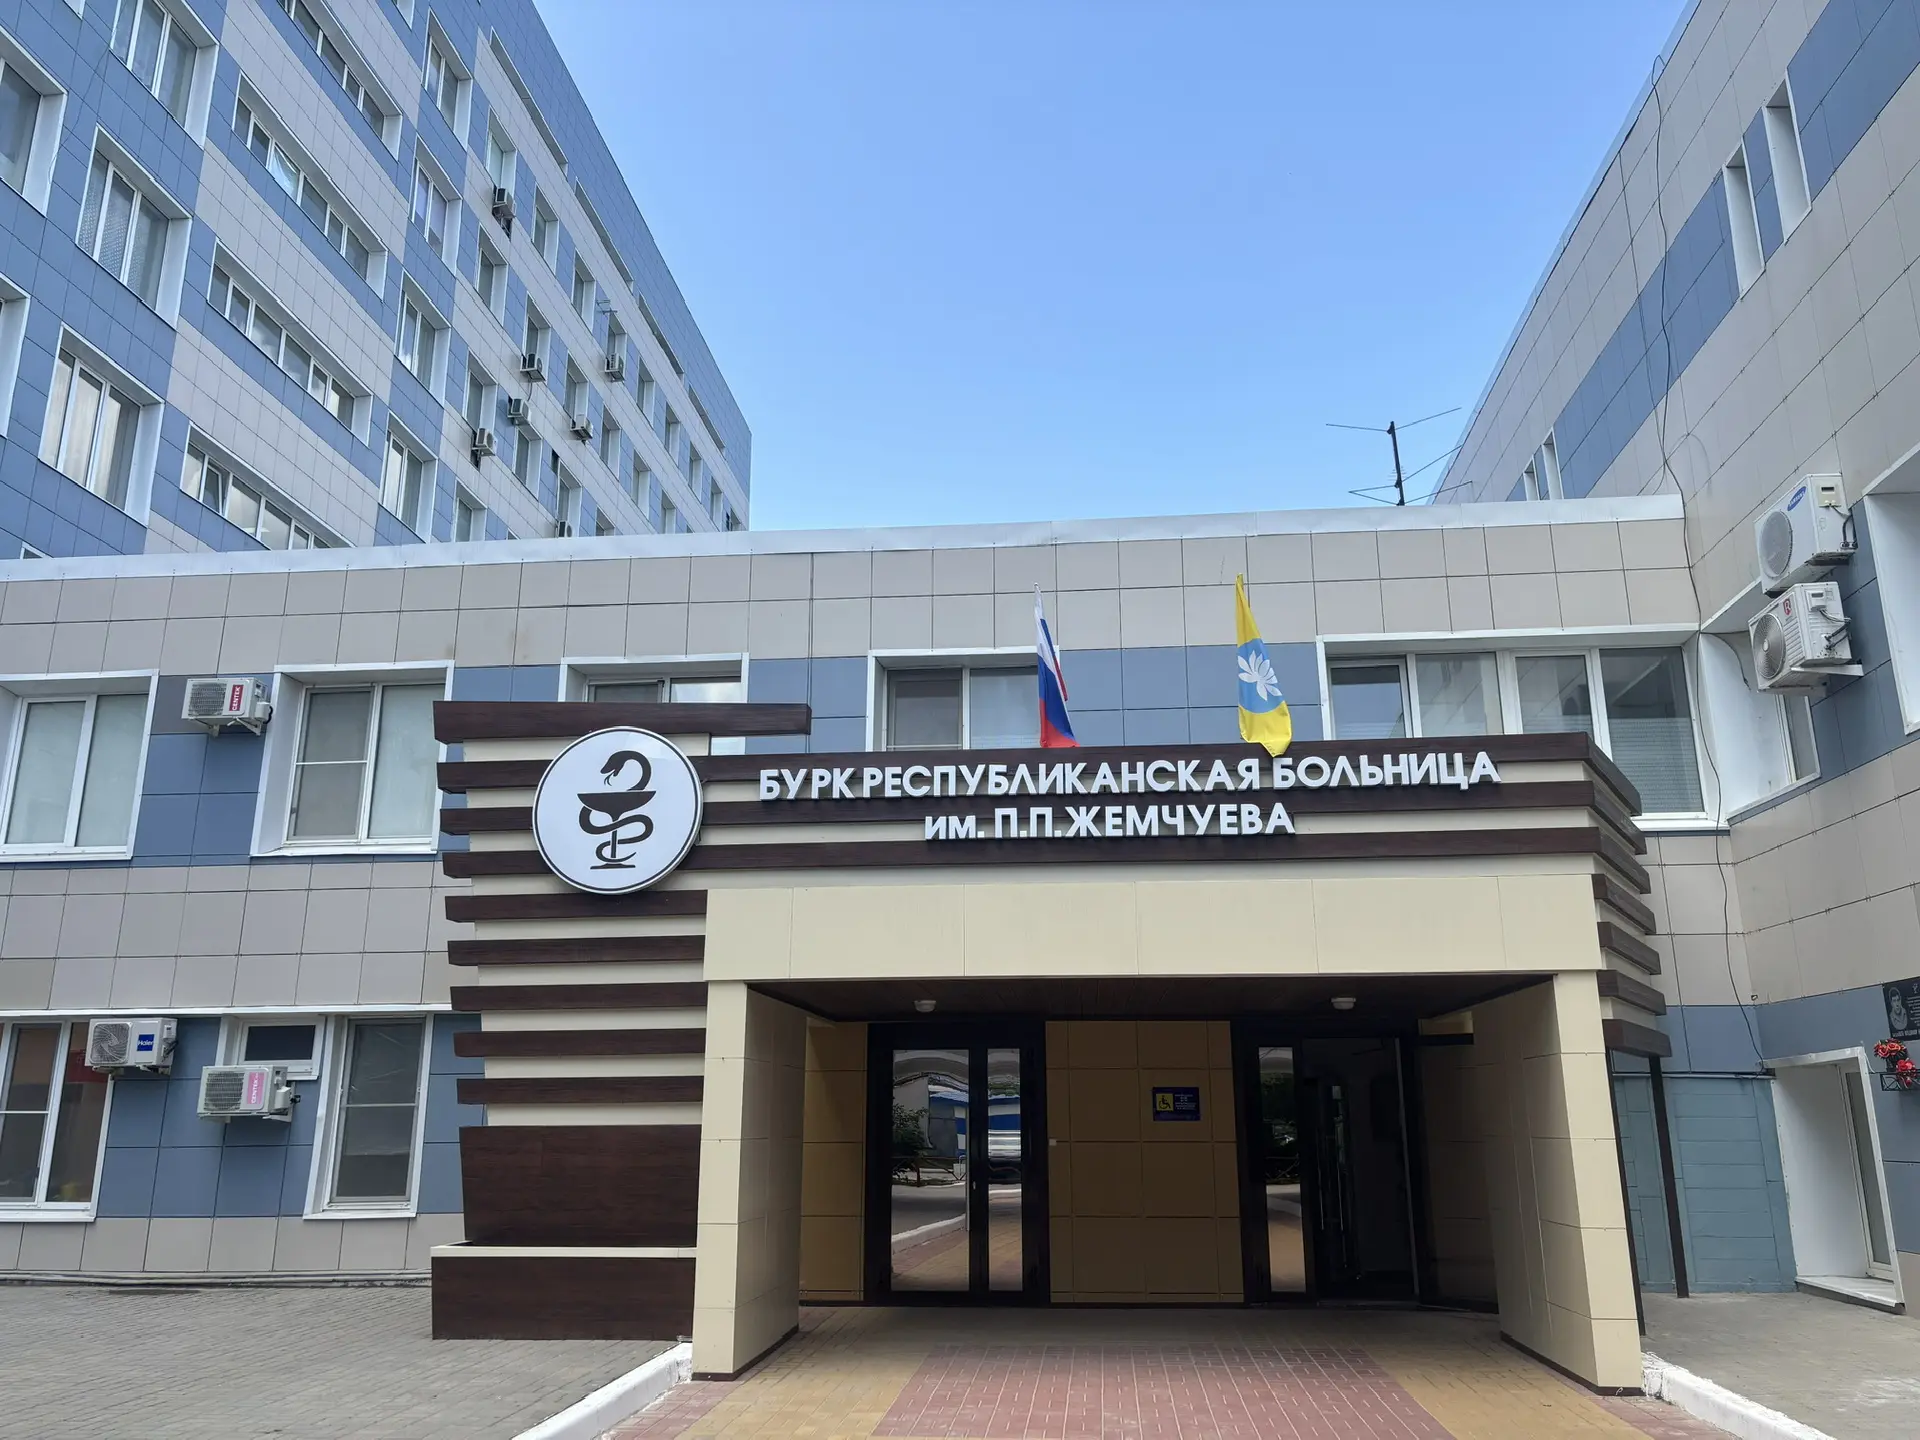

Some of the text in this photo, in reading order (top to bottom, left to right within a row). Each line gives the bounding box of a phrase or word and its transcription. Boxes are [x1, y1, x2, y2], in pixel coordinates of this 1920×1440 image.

[231, 686, 241, 711] CENTEK
[862, 757, 1261, 799] РЕСПУБЛИКАНСКАЯ
[1272, 751, 1502, 791] БОЛЬНИЦА
